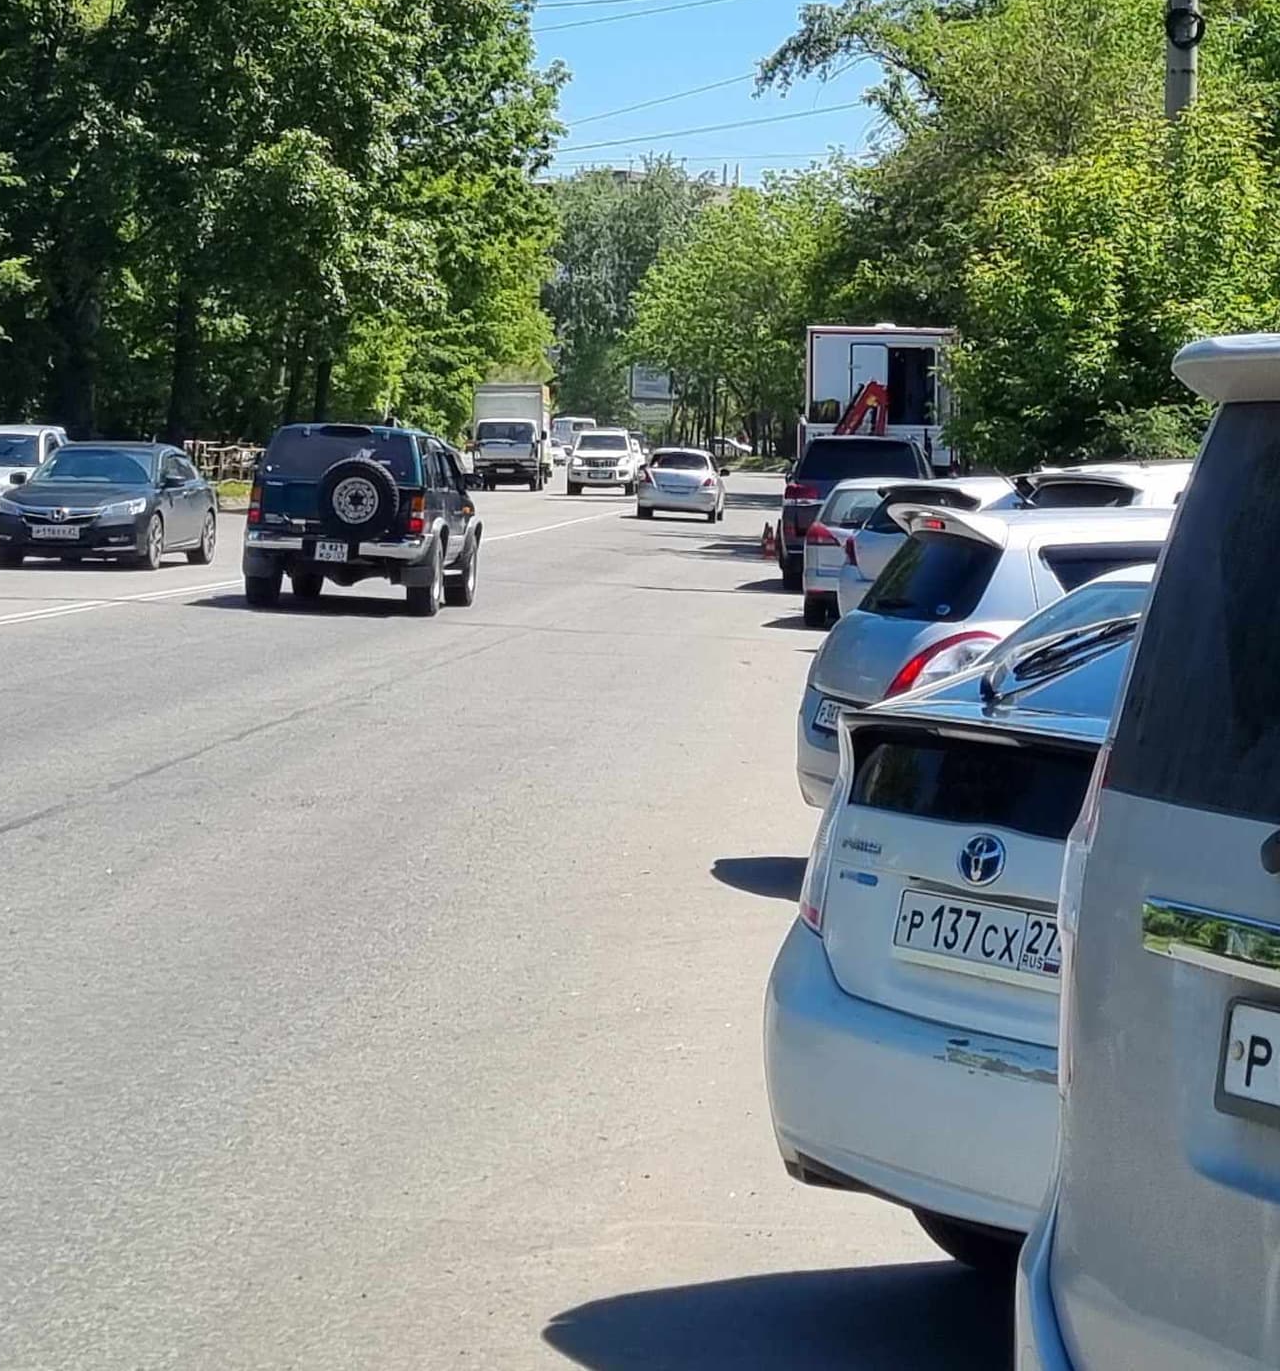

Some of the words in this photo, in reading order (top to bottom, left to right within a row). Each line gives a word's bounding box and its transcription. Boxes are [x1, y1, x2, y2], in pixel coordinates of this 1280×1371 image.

[906, 904, 1020, 963] Р137СХ
[1026, 920, 1059, 957] 27
[1022, 953, 1043, 969] RUS
